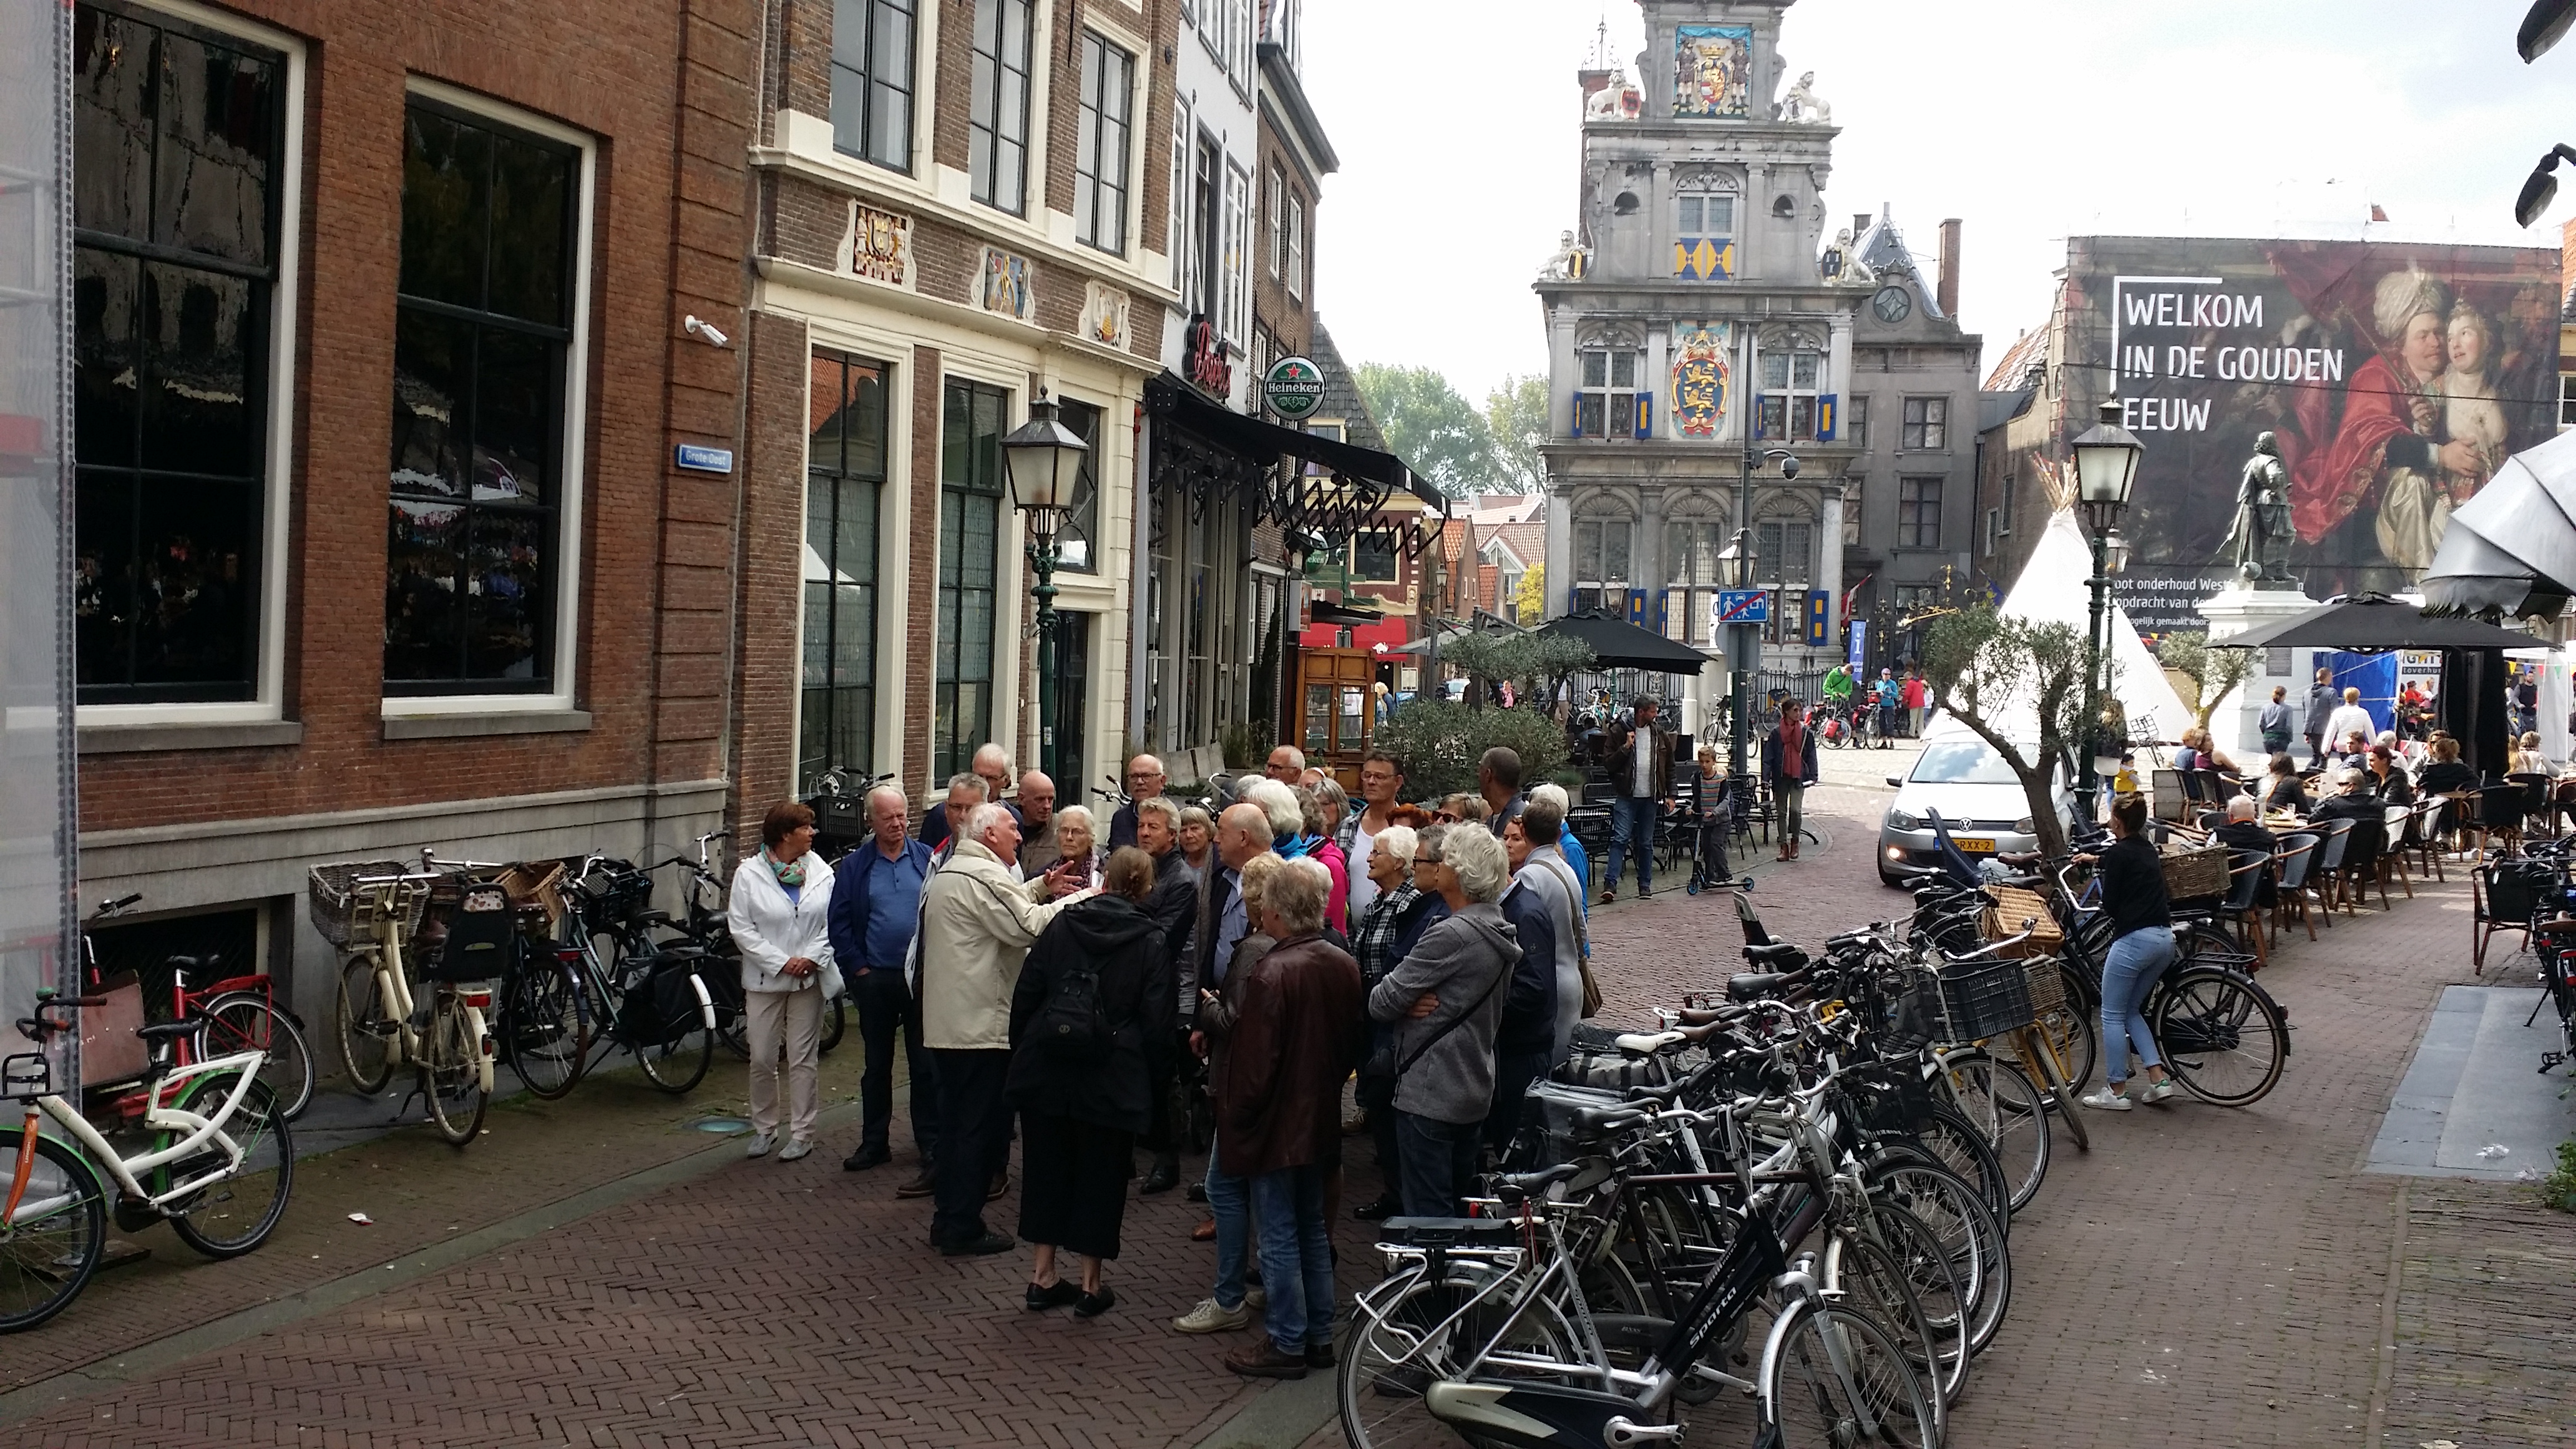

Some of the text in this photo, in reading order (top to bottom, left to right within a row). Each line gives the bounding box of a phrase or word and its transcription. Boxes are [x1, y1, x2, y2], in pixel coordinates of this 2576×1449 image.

[2125, 293, 2264, 328] WELKOM
[2124, 345, 2343, 382] IN DE GOUDEN
[1267, 382, 1320, 393] Heineken
[2122, 397, 2212, 432] EEUW
[686, 451, 726, 466] Grote Oost
[2114, 578, 2134, 590] oot
[2137, 578, 2196, 590] onderhoud
[2116, 595, 2166, 610] opdracht
[2170, 598, 2189, 609] van
[2156, 617, 2188, 627] gemaakt
[1956, 841, 1990, 850] -RXX-2
